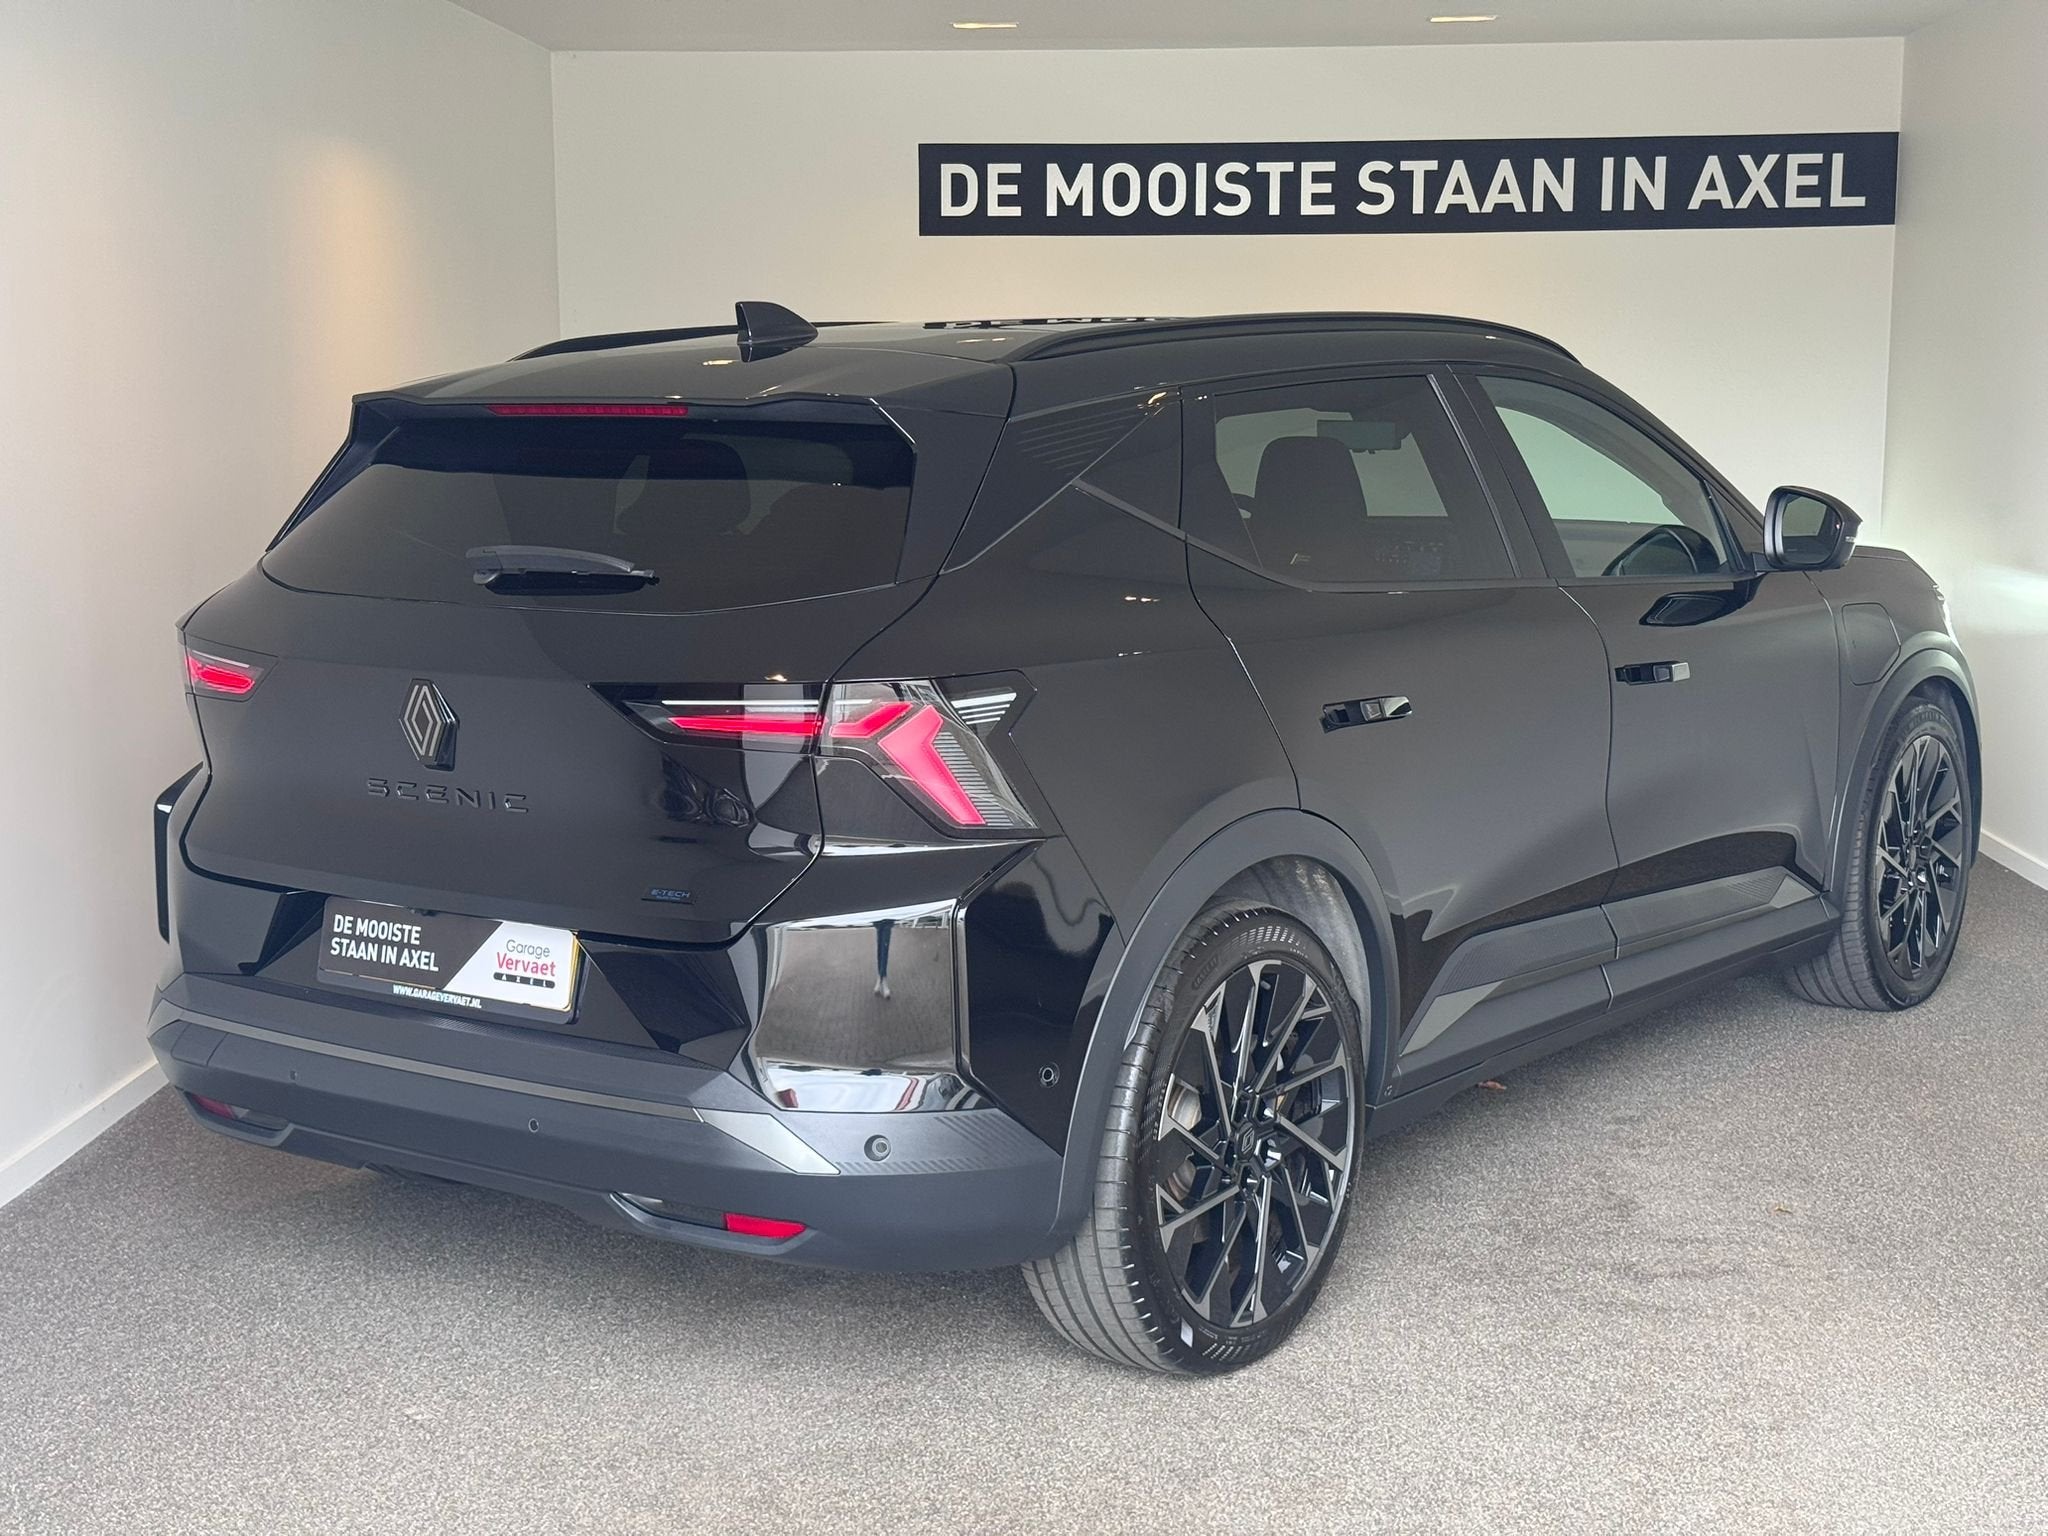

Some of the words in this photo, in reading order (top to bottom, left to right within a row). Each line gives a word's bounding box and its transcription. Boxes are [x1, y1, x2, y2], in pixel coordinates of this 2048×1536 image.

[940, 163, 1022, 217] DE
[1046, 161, 1336, 217] MOOISTE
[1355, 157, 1575, 216] STAAN
[1600, 156, 1667, 212] IN
[1687, 152, 1866, 210] AXEL
[367, 777, 528, 813] SCENIC
[333, 914, 354, 935] DE
[355, 917, 422, 945] MOOISTE
[330, 937, 379, 962] STAAN
[380, 944, 398, 965] IN
[399, 948, 440, 972] AXEL
[497, 951, 556, 977] Vervaet
[506, 939, 550, 960] Garage
[392, 984, 482, 1009] WWW.GARAGEVERVAET.NL
